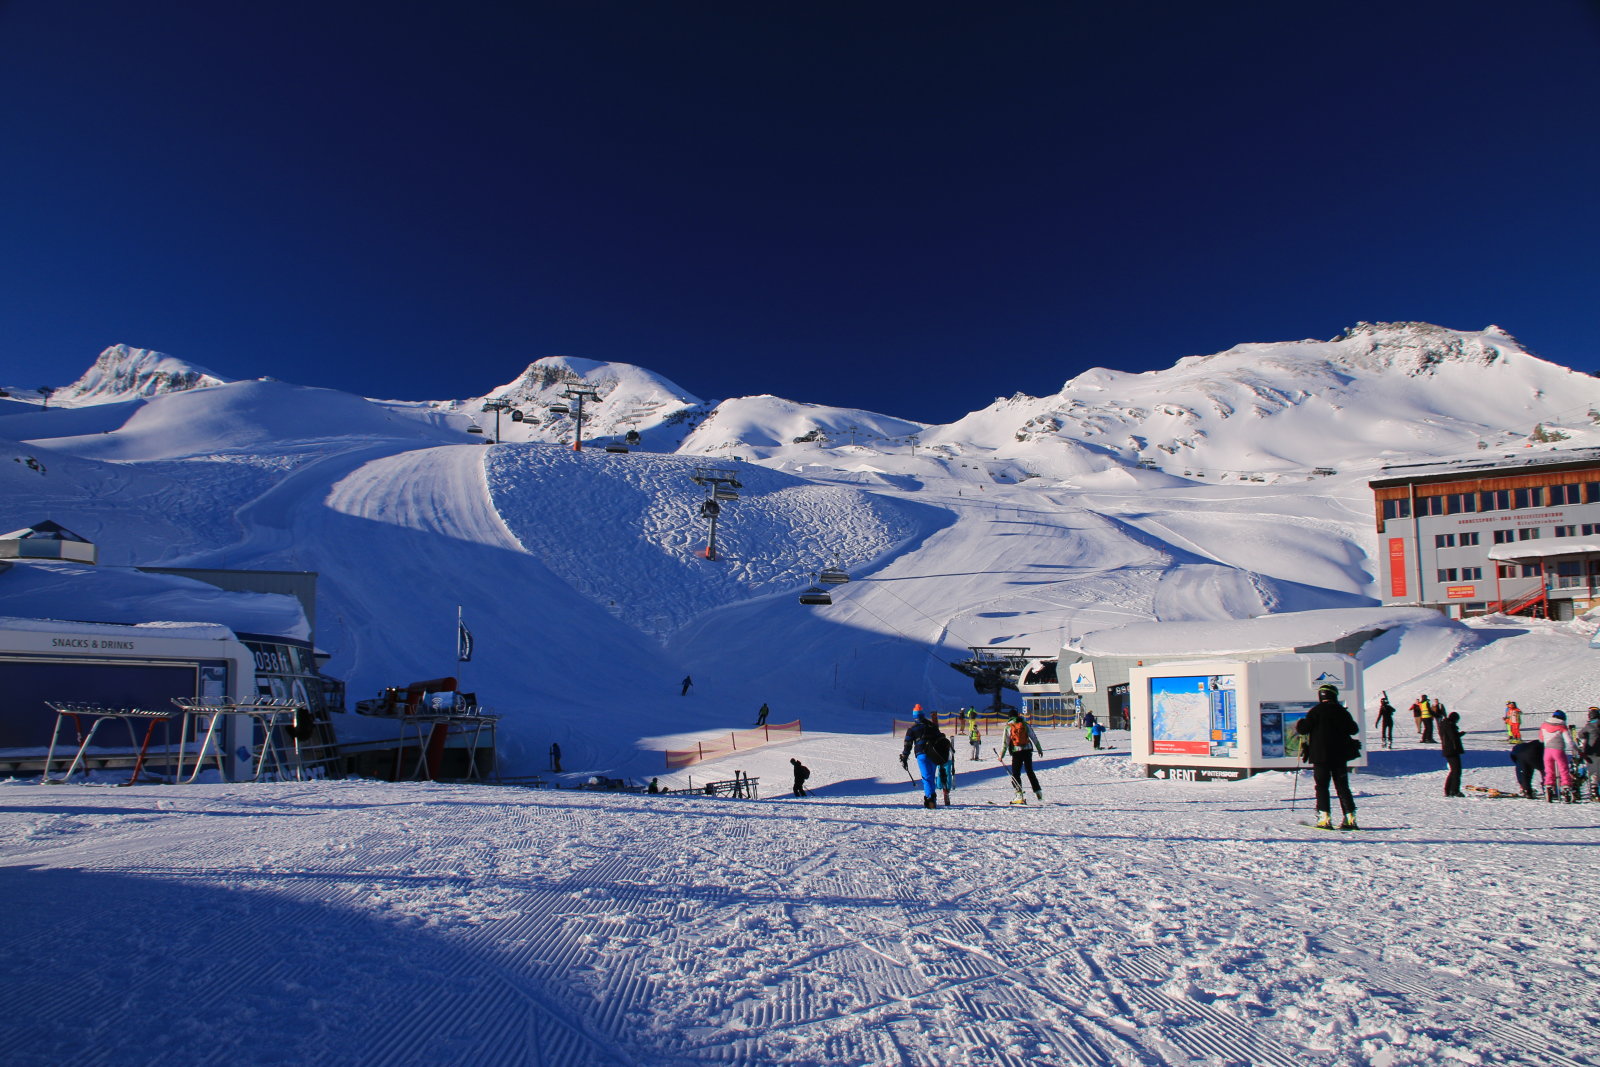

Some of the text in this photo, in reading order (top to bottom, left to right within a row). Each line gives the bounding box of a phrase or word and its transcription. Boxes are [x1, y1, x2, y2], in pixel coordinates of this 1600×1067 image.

[52, 638, 134, 650] SNACKS & DRINKS
[1169, 768, 1197, 782] RENT
